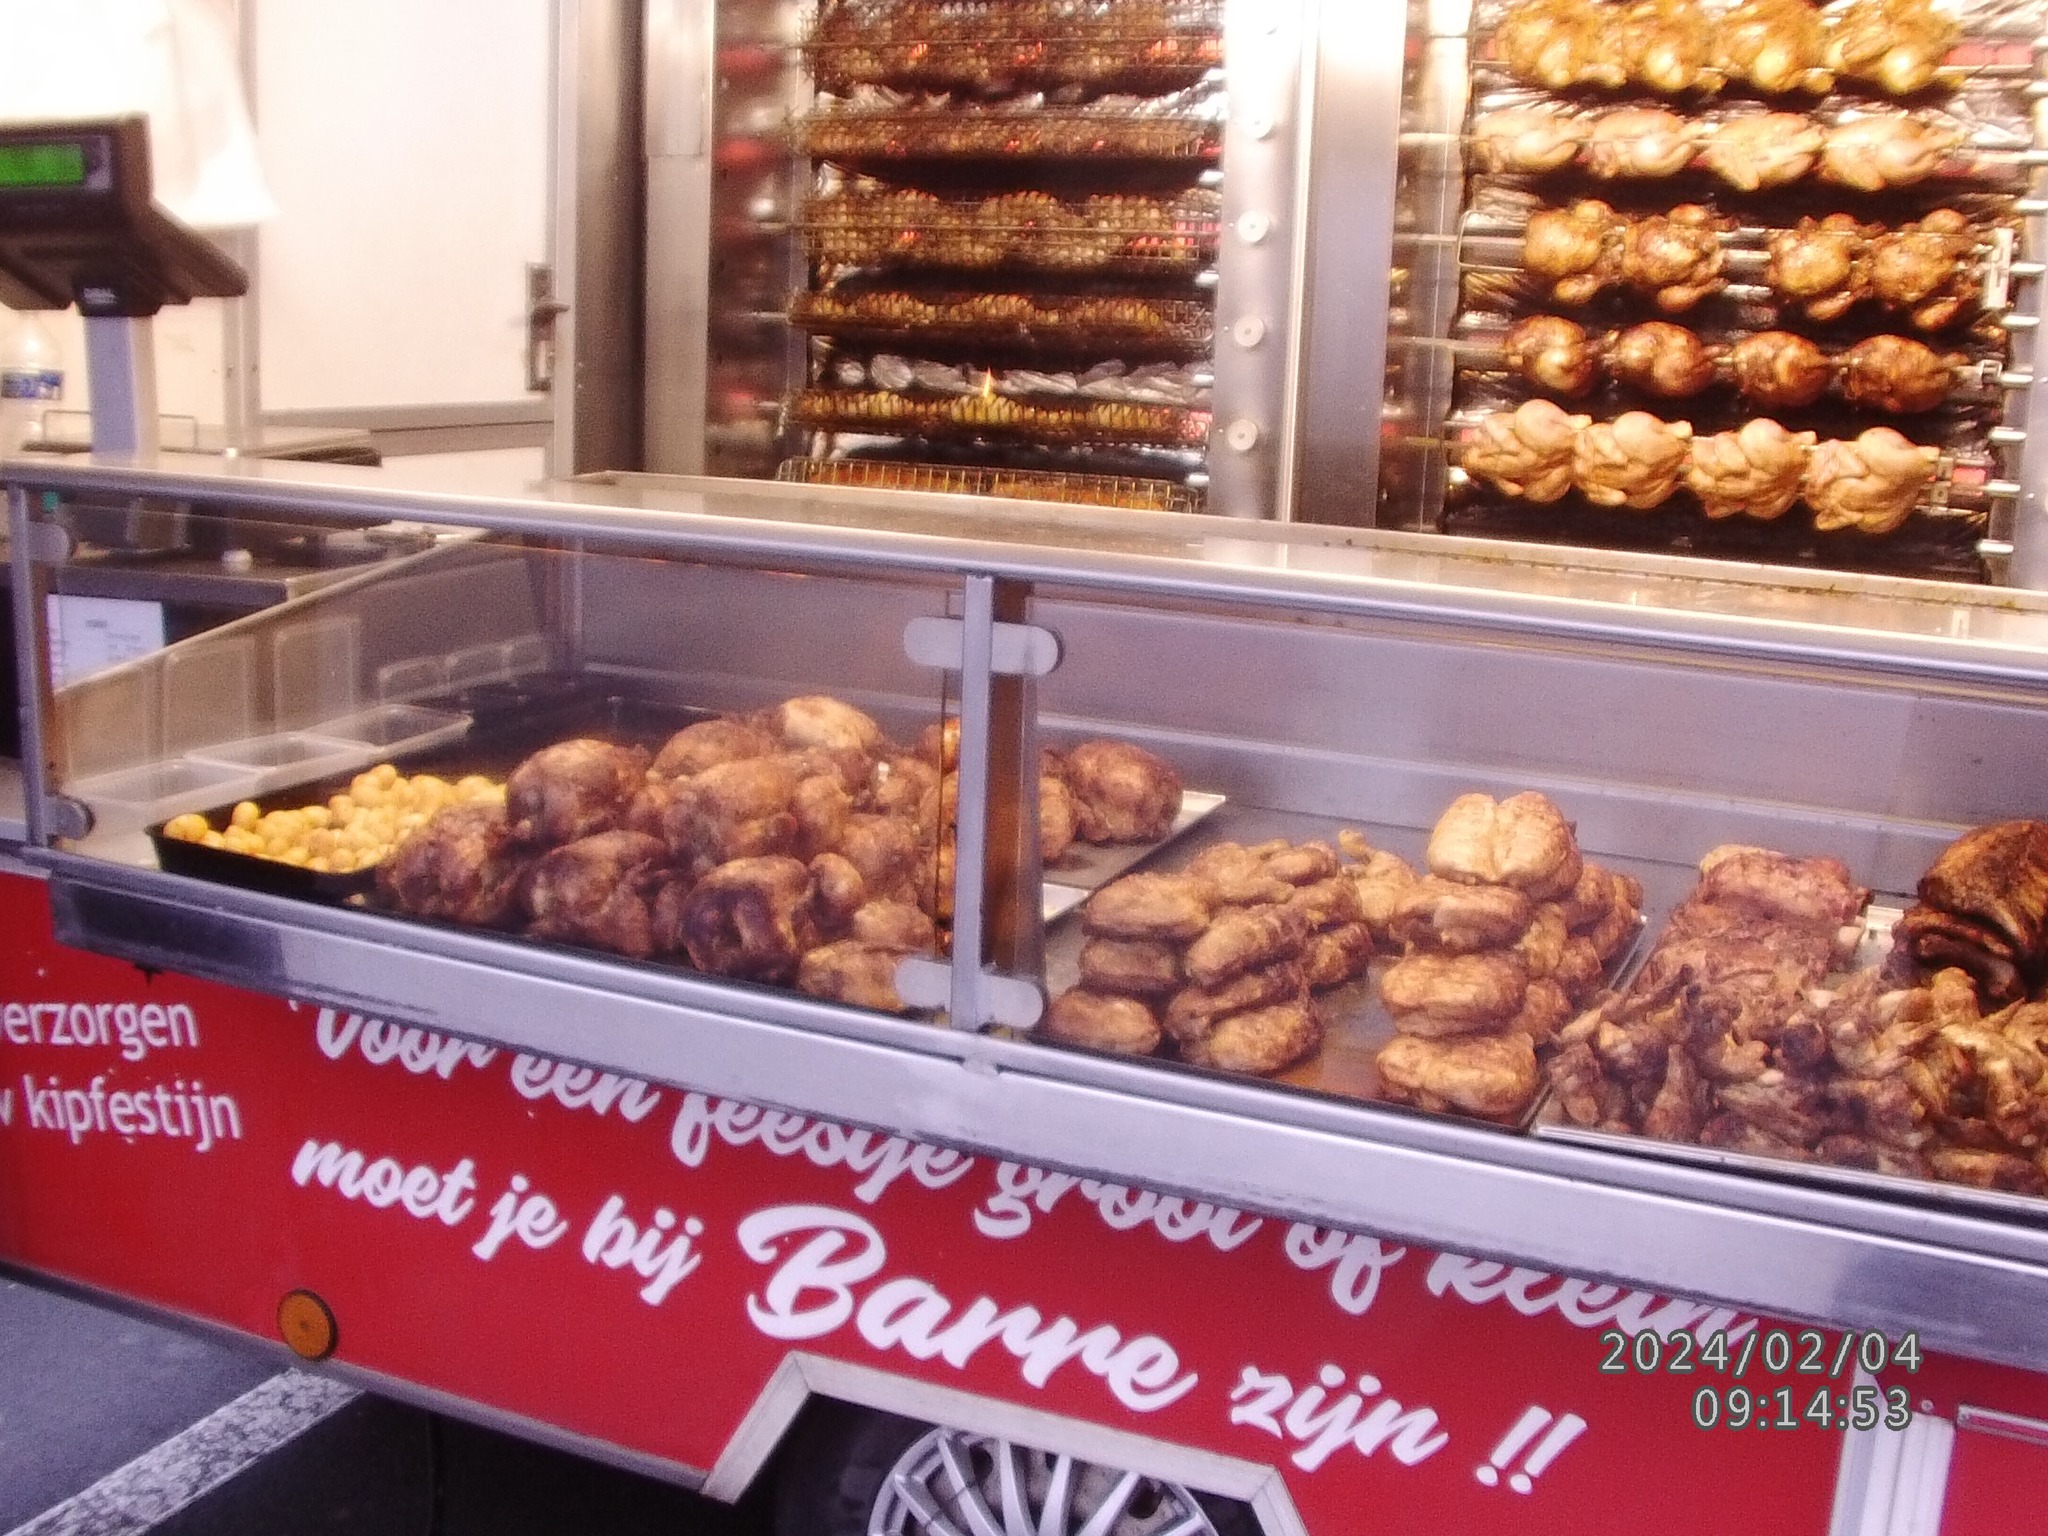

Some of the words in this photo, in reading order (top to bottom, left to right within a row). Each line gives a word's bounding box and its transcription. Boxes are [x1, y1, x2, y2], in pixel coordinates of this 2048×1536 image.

[0, 1002, 199, 1061] erzorgen
[23, 1073, 241, 1152] kipfestijn
[288, 1000, 497, 1080] Voor
[511, 1053, 660, 1122] een
[1285, 1222, 1406, 1316] of
[292, 1139, 476, 1227] moet
[472, 1174, 568, 1262] je
[582, 1194, 704, 1306] bij
[737, 1204, 1199, 1412] Barre
[1231, 1364, 1449, 1472] zijn
[1475, 1405, 1588, 1494] !!
